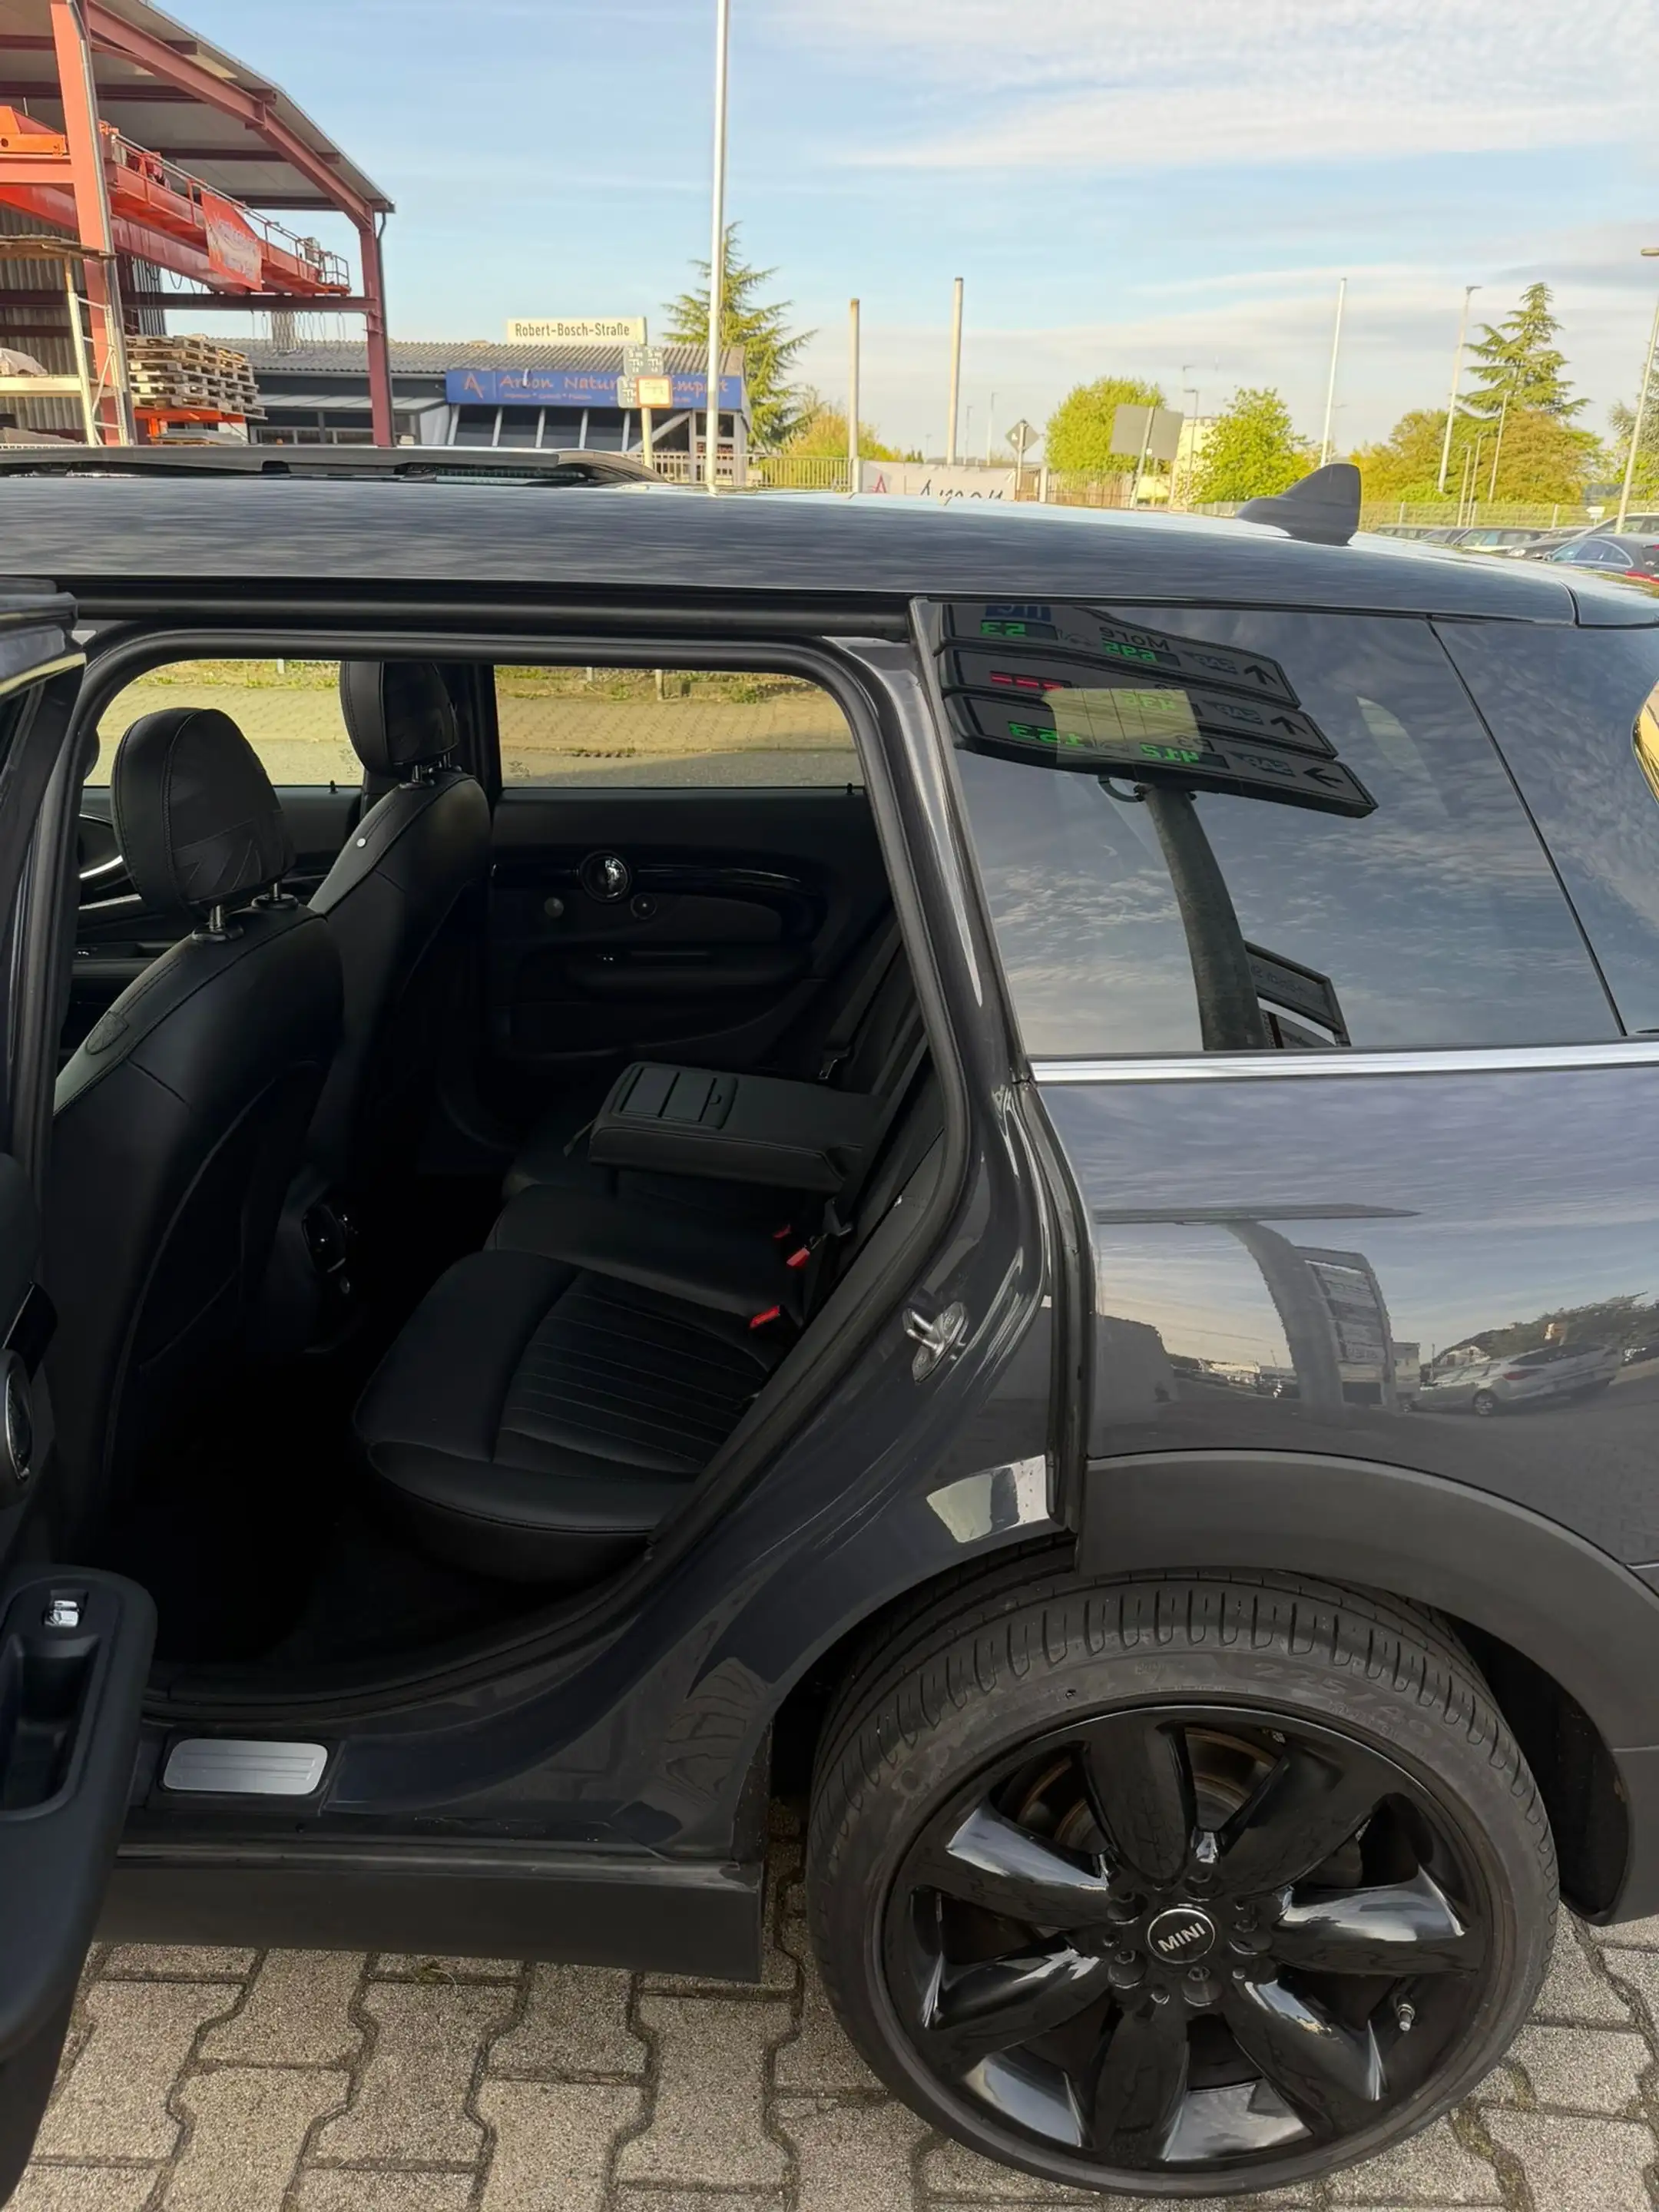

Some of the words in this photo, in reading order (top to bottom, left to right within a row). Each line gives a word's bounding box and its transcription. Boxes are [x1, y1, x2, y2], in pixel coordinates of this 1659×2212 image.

[515, 323, 630, 336] Robert-Bosch-Straße
[564, 377, 618, 390] Natur
[1158, 1922, 1206, 1952] MINI
